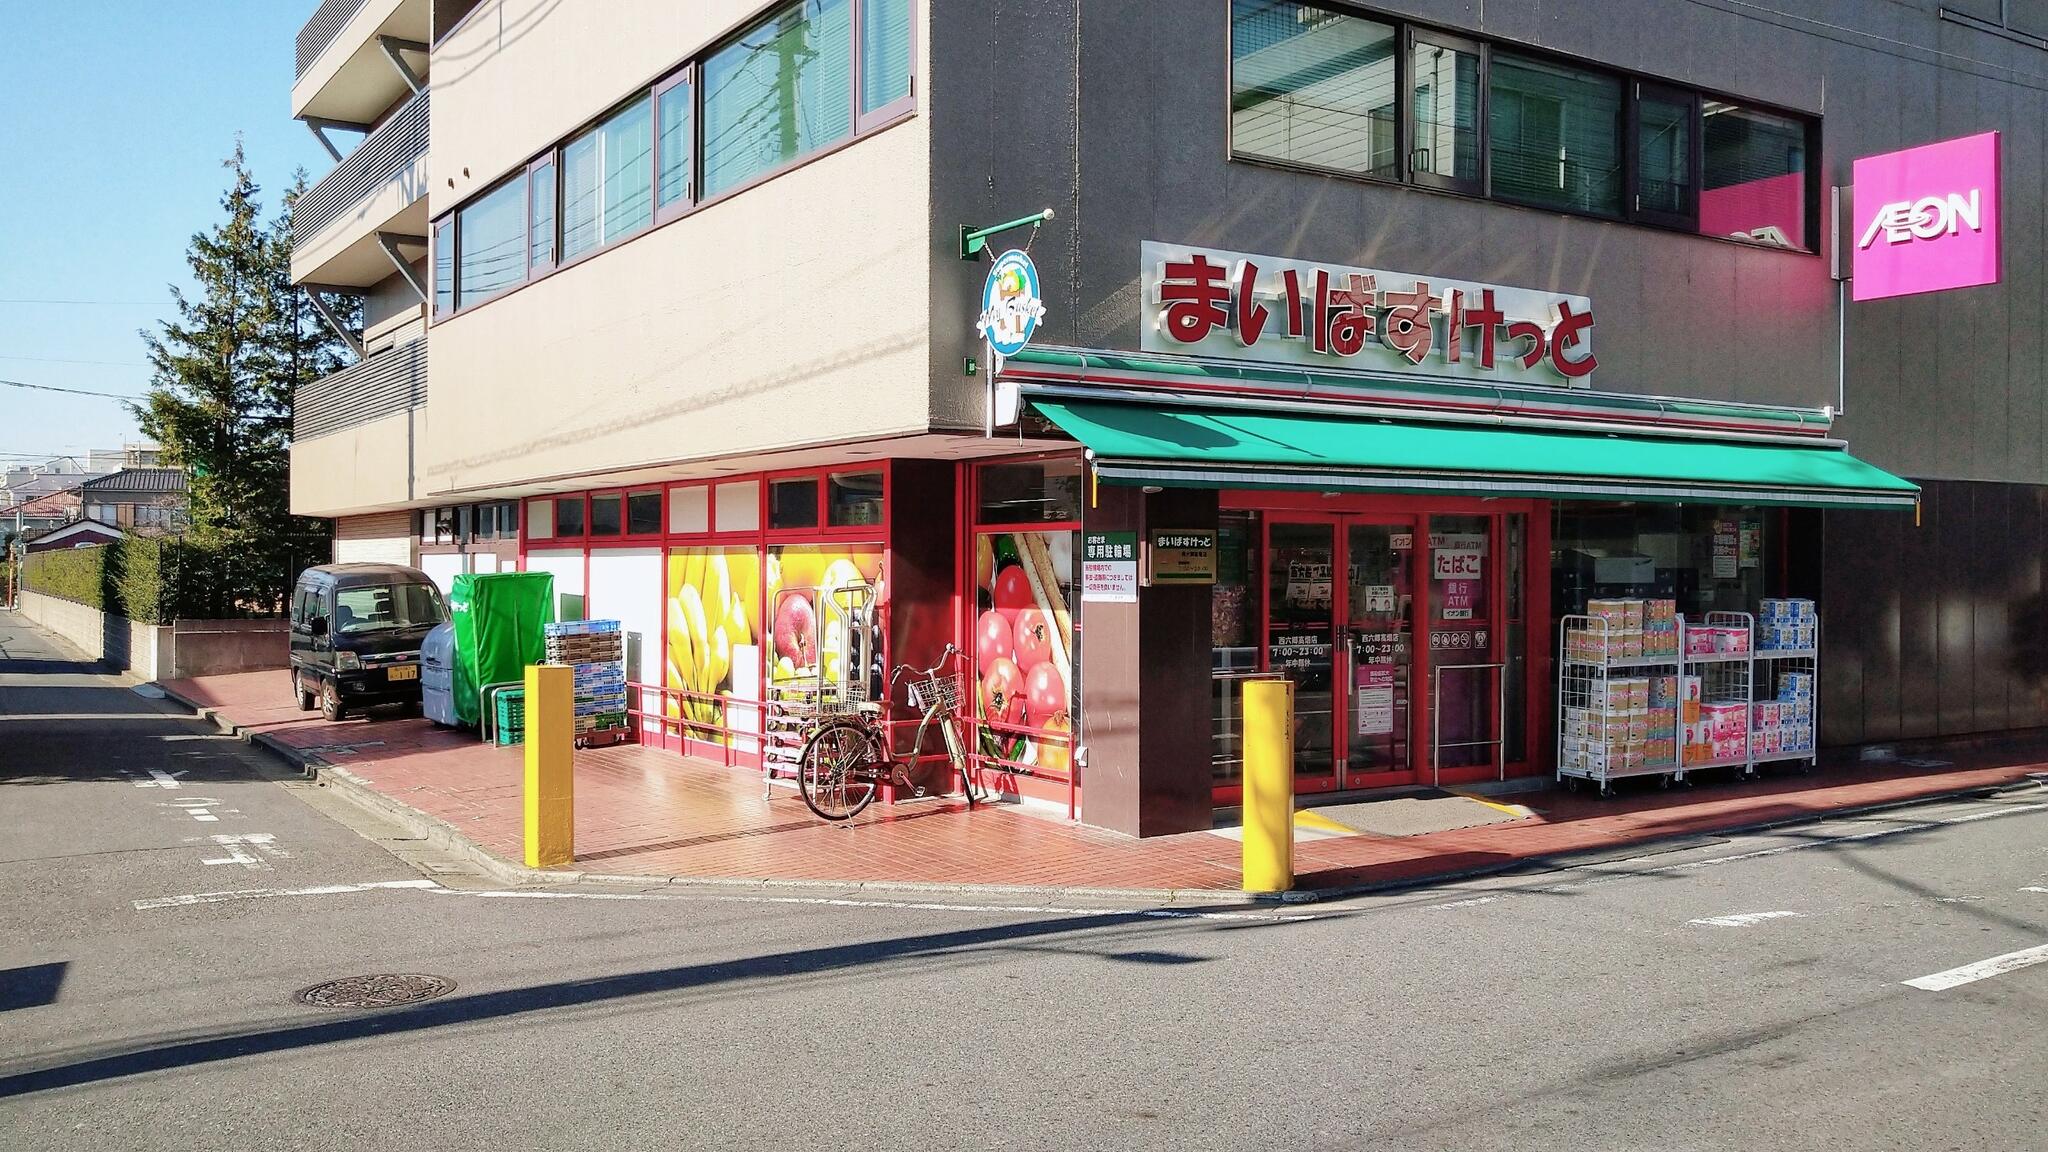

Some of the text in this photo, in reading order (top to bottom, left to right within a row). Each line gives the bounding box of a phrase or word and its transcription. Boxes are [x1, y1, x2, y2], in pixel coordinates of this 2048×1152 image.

[1152, 254, 1599, 378] まいばすけっと
[1087, 536, 1105, 544] お客さま
[1158, 537, 1211, 547] まいばすけっと
[1087, 545, 1131, 558] 専用駐輪場
[1438, 555, 1478, 573] たばこ
[1448, 582, 1468, 594] 銀行
[1448, 596, 1468, 606] ATM
